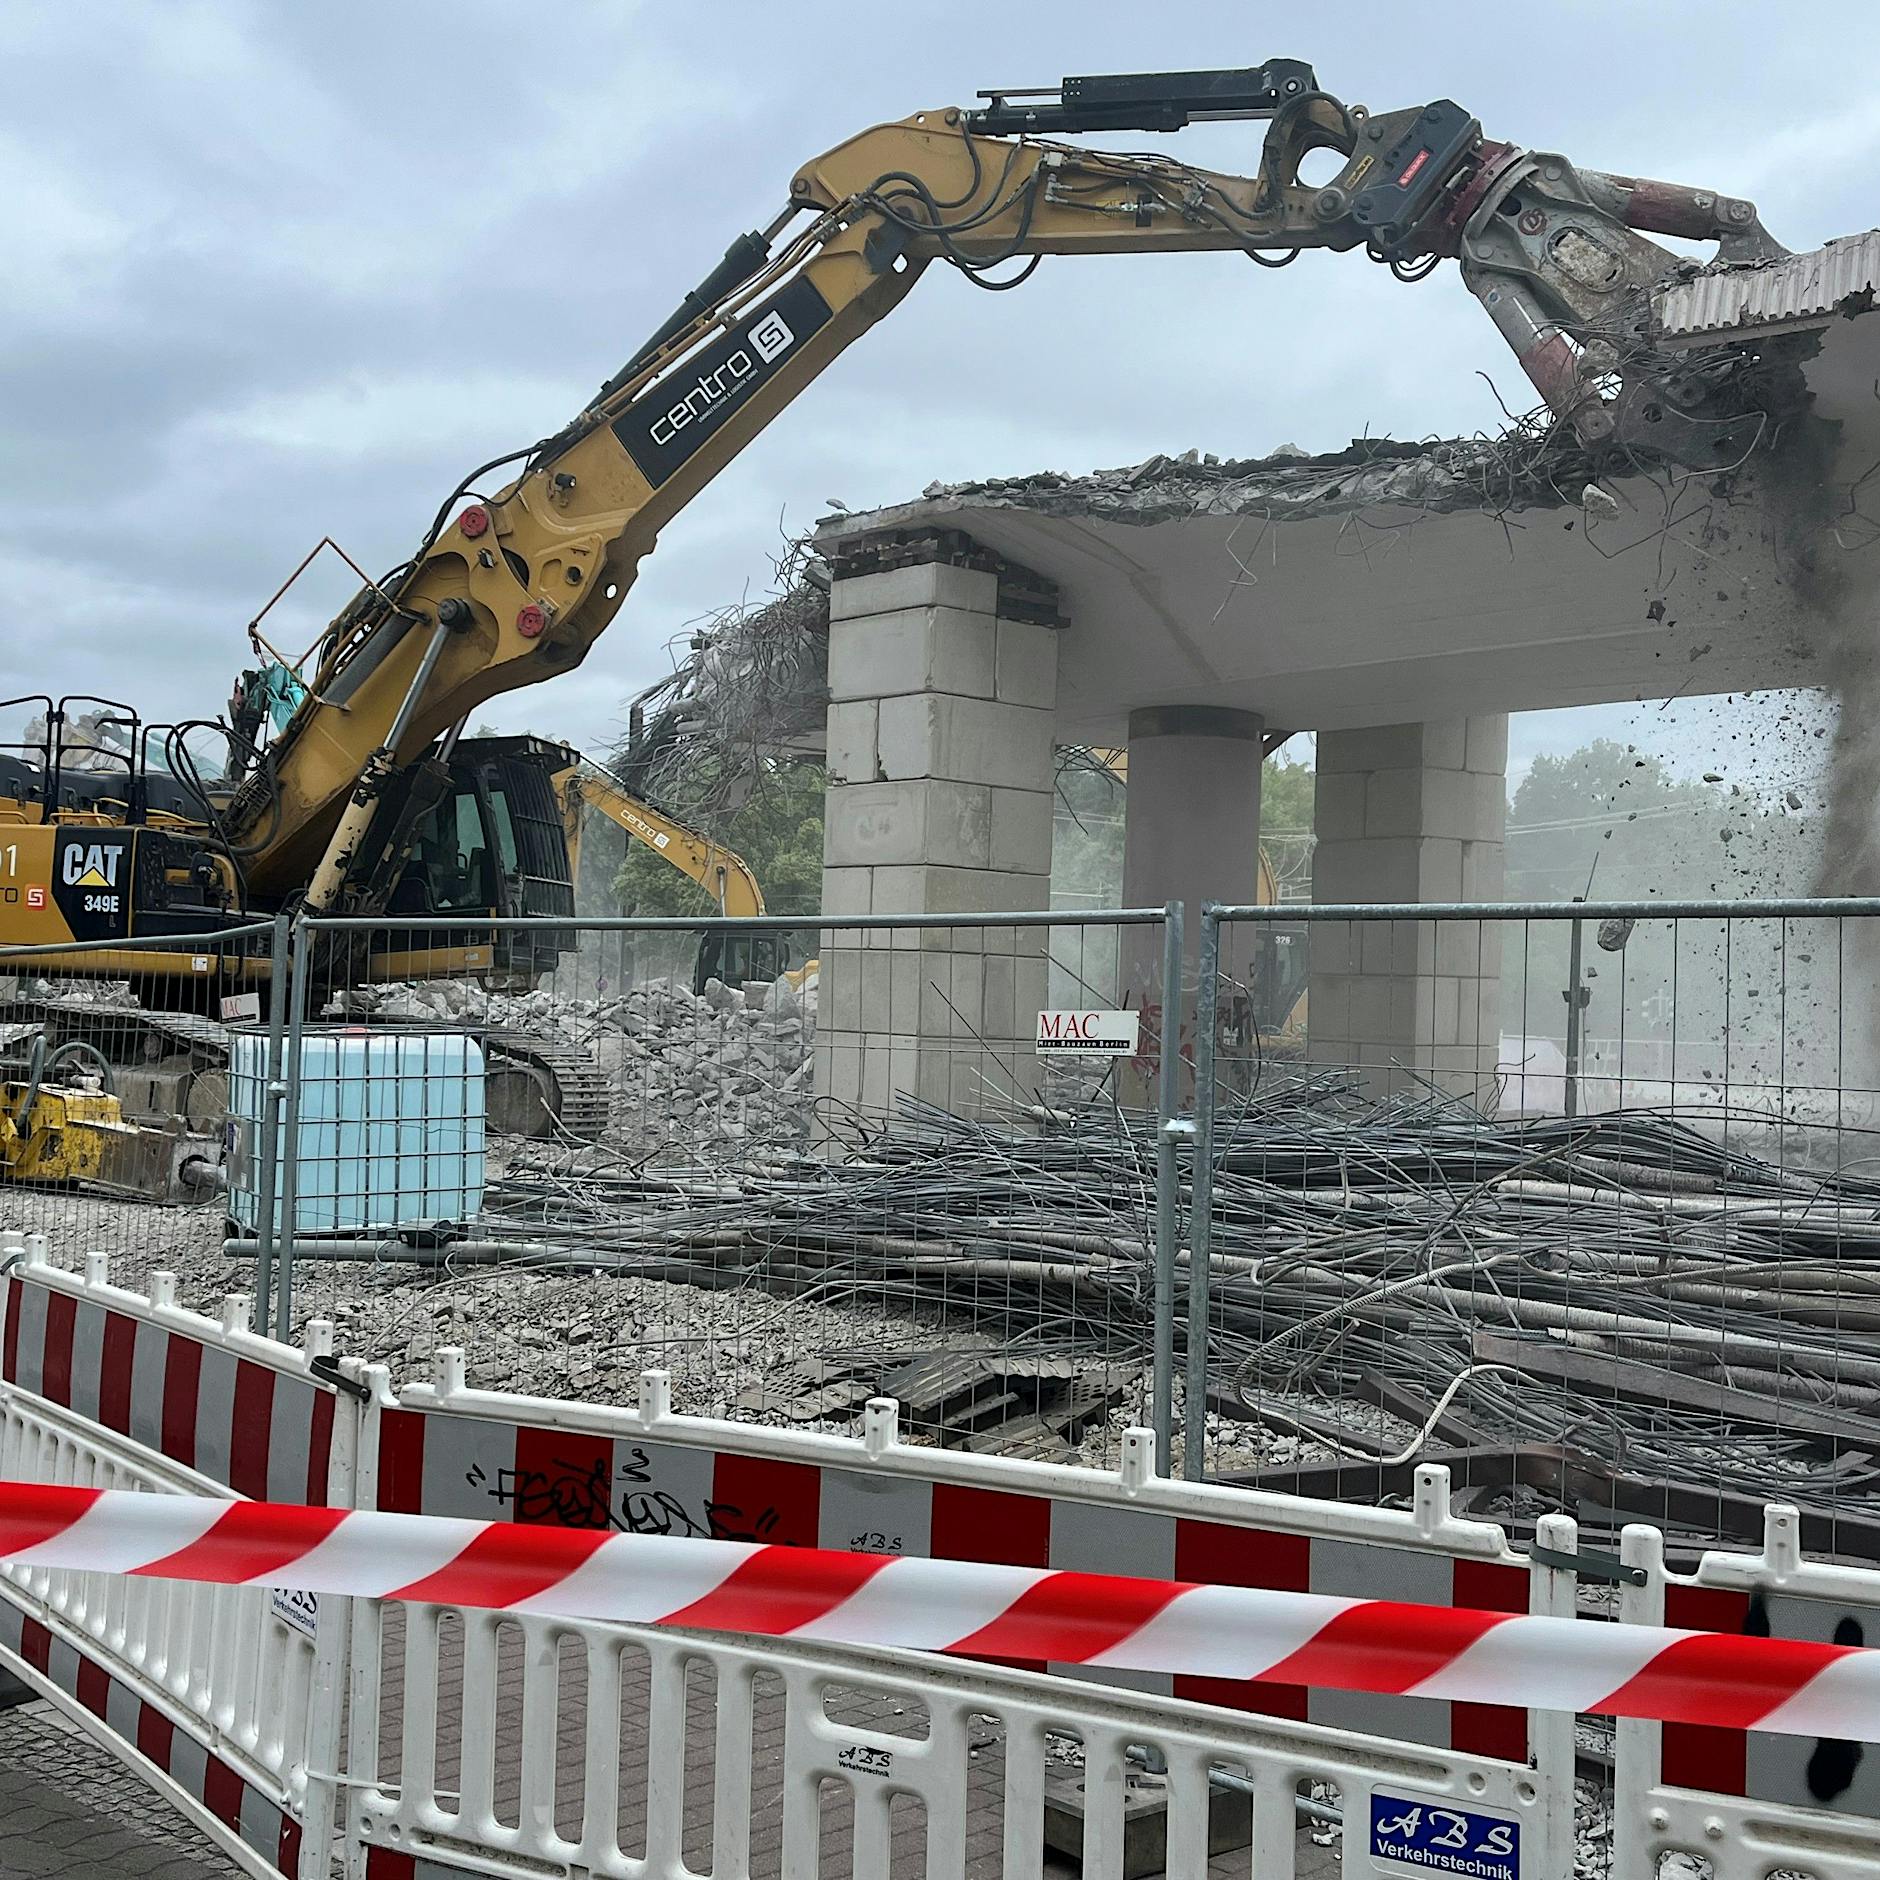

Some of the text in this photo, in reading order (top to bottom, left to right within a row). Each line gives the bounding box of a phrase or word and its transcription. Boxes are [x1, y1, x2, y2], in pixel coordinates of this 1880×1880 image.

[650, 350, 752, 445] centro
[621, 809, 656, 837] centro
[63, 843, 124, 887] CAT
[84, 894, 120, 913] 349E
[1041, 1013, 1100, 1038] MAC
[1100, 1040, 1128, 1048] Berlin
[273, 1595, 316, 1629] Verkehrstechnik
[274, 1588, 317, 1614] BS
[838, 1759, 890, 1778] Verkehrstechnik
[1376, 1838, 1514, 1880] Verkehrstechnik
